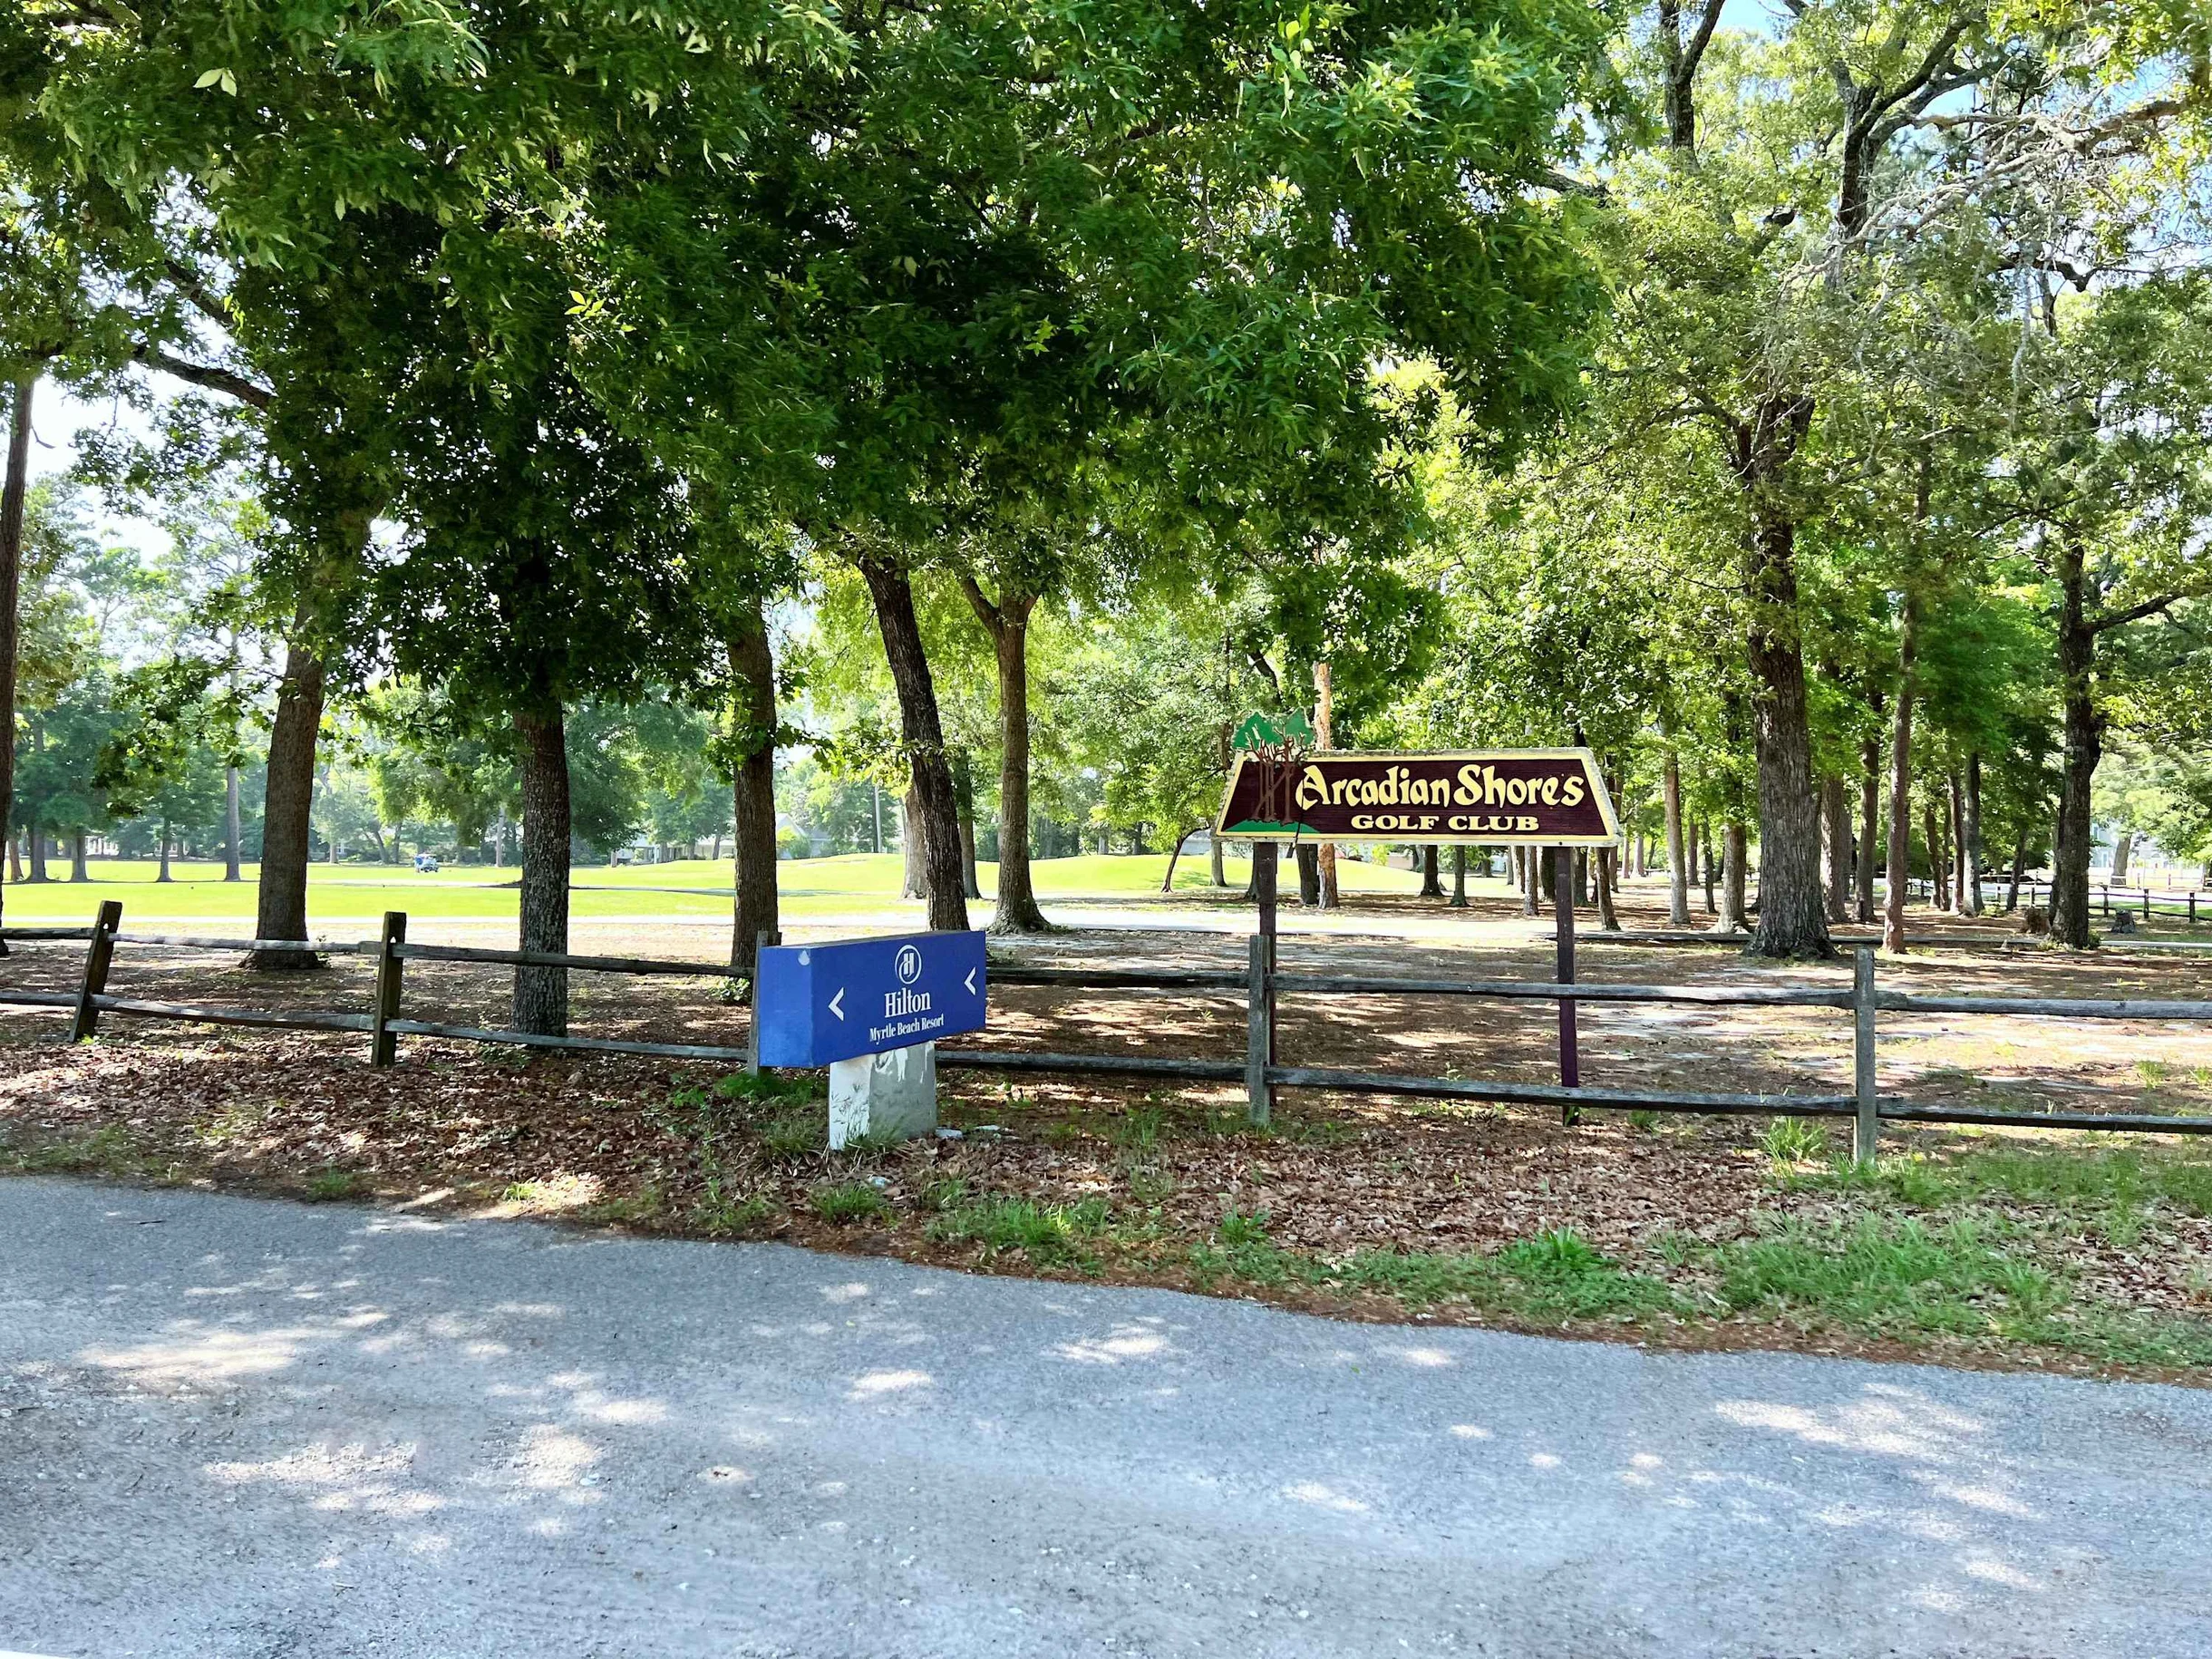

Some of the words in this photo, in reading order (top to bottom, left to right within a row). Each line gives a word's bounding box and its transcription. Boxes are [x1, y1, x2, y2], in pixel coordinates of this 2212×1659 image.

[1295, 764, 1450, 810] Arcadian
[1453, 764, 1584, 808] Shores
[1351, 815, 1440, 831] GOLF
[1448, 816, 1539, 831] CLUB
[884, 987, 931, 1018] Hilton
[869, 1024, 897, 1045] Myrtle
[897, 1018, 920, 1035] Beach
[921, 1013, 944, 1031] Resort
